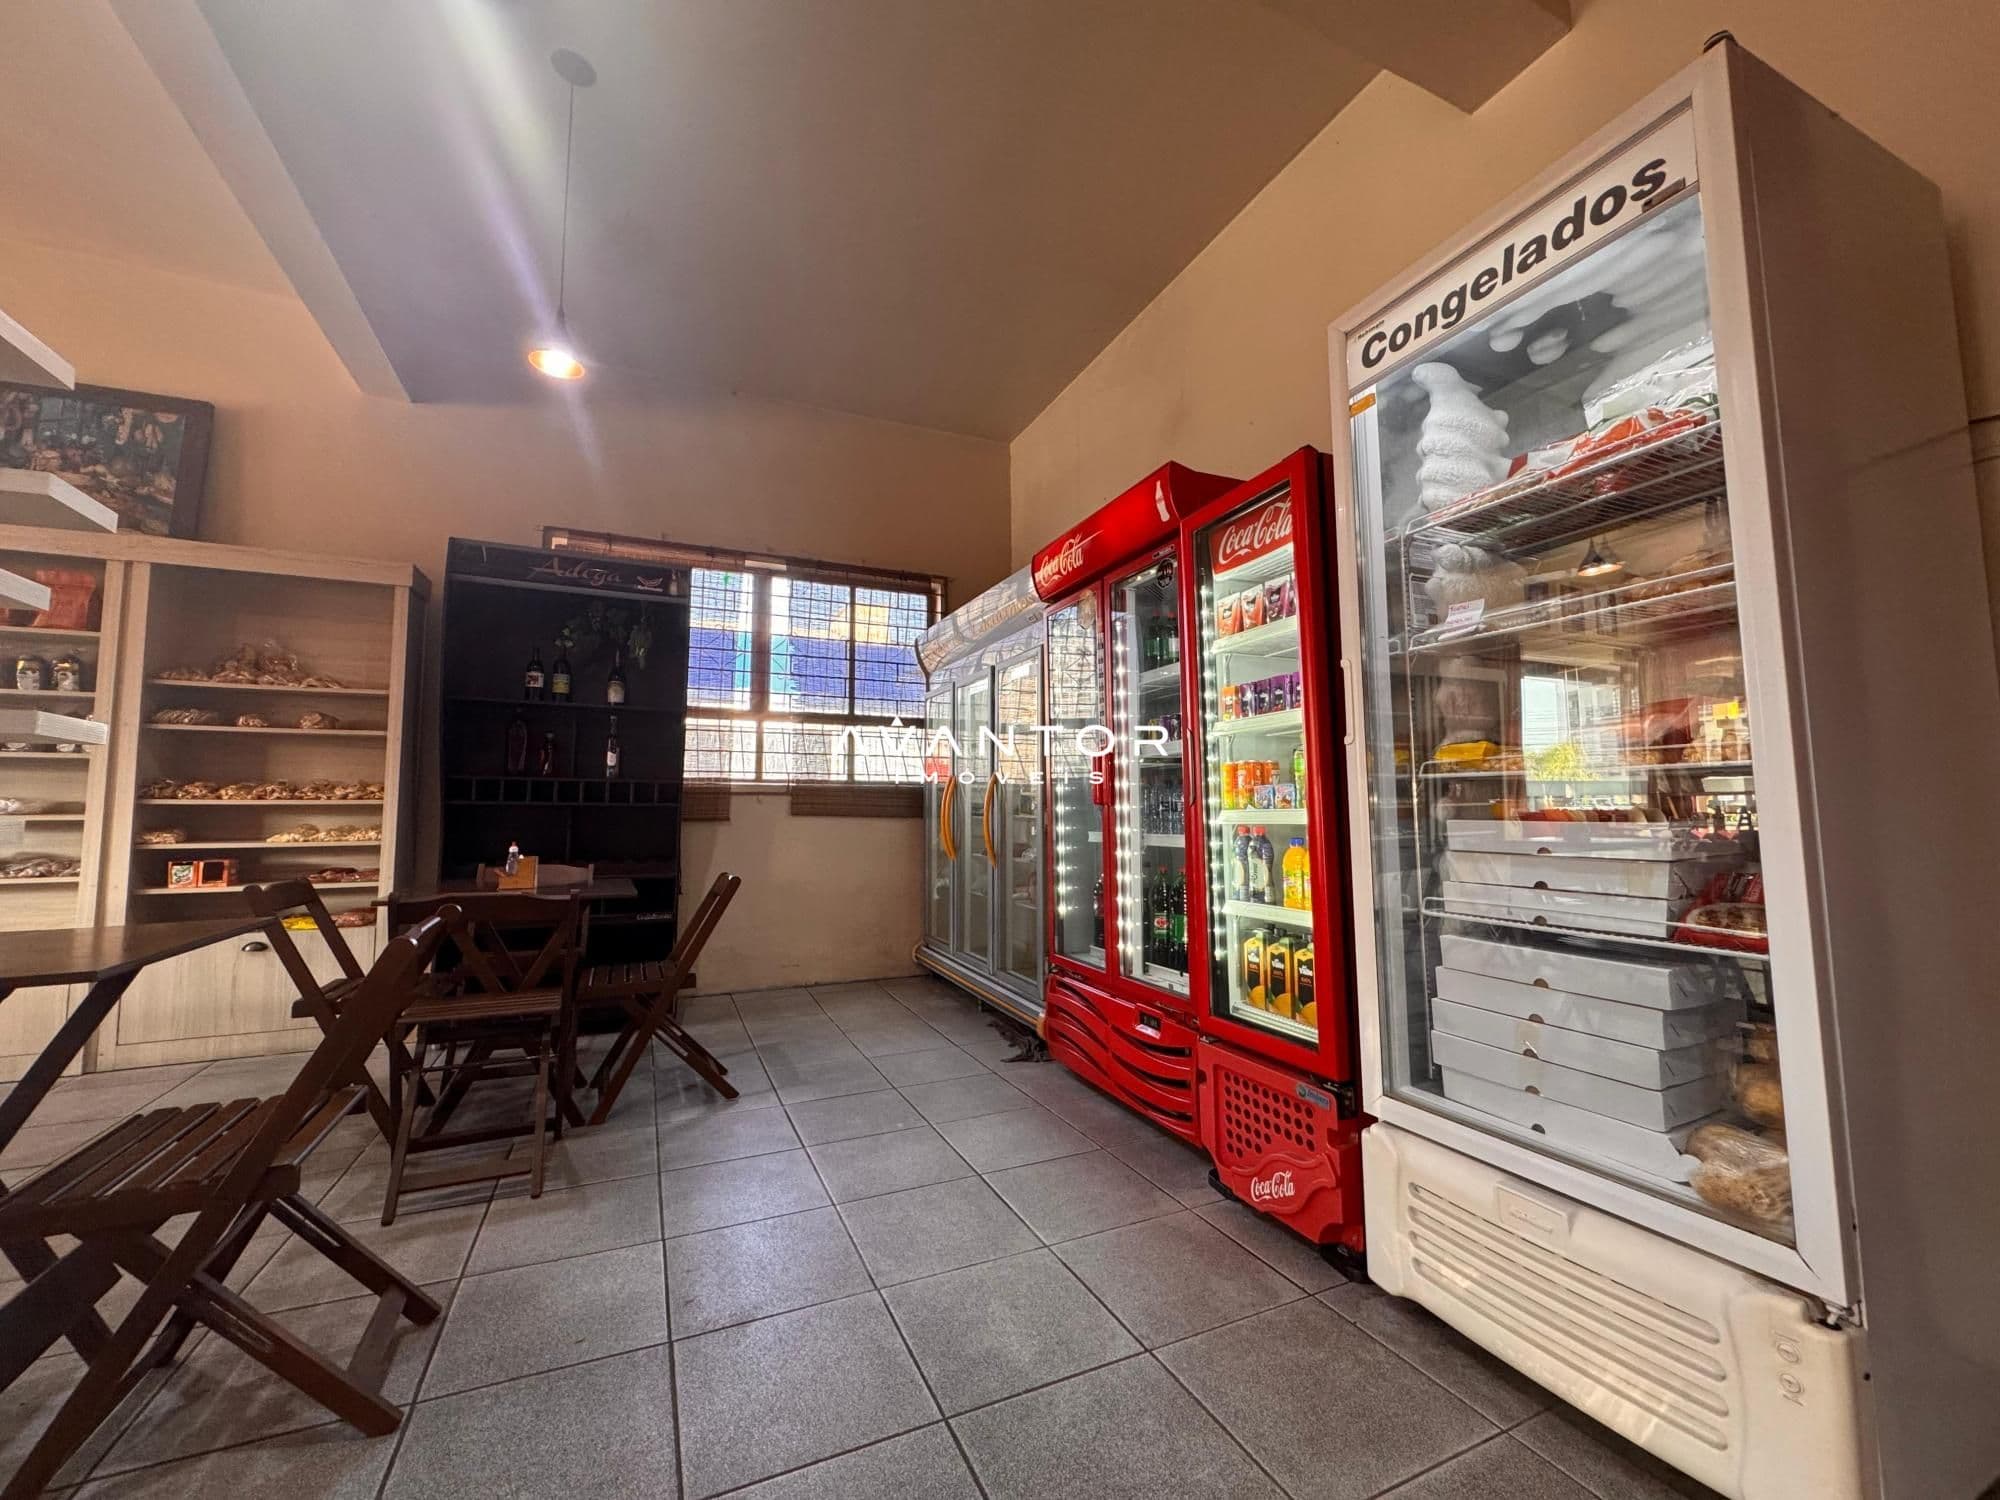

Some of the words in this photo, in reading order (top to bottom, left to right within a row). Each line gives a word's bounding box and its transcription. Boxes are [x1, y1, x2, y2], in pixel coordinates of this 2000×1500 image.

[1361, 158, 1667, 369] Congelados
[1218, 496, 1293, 565] Coca-Cola
[527, 557, 622, 587] Adega
[1038, 533, 1084, 587] Coca-Cola
[1250, 1170, 1295, 1202] Coca-Cola
